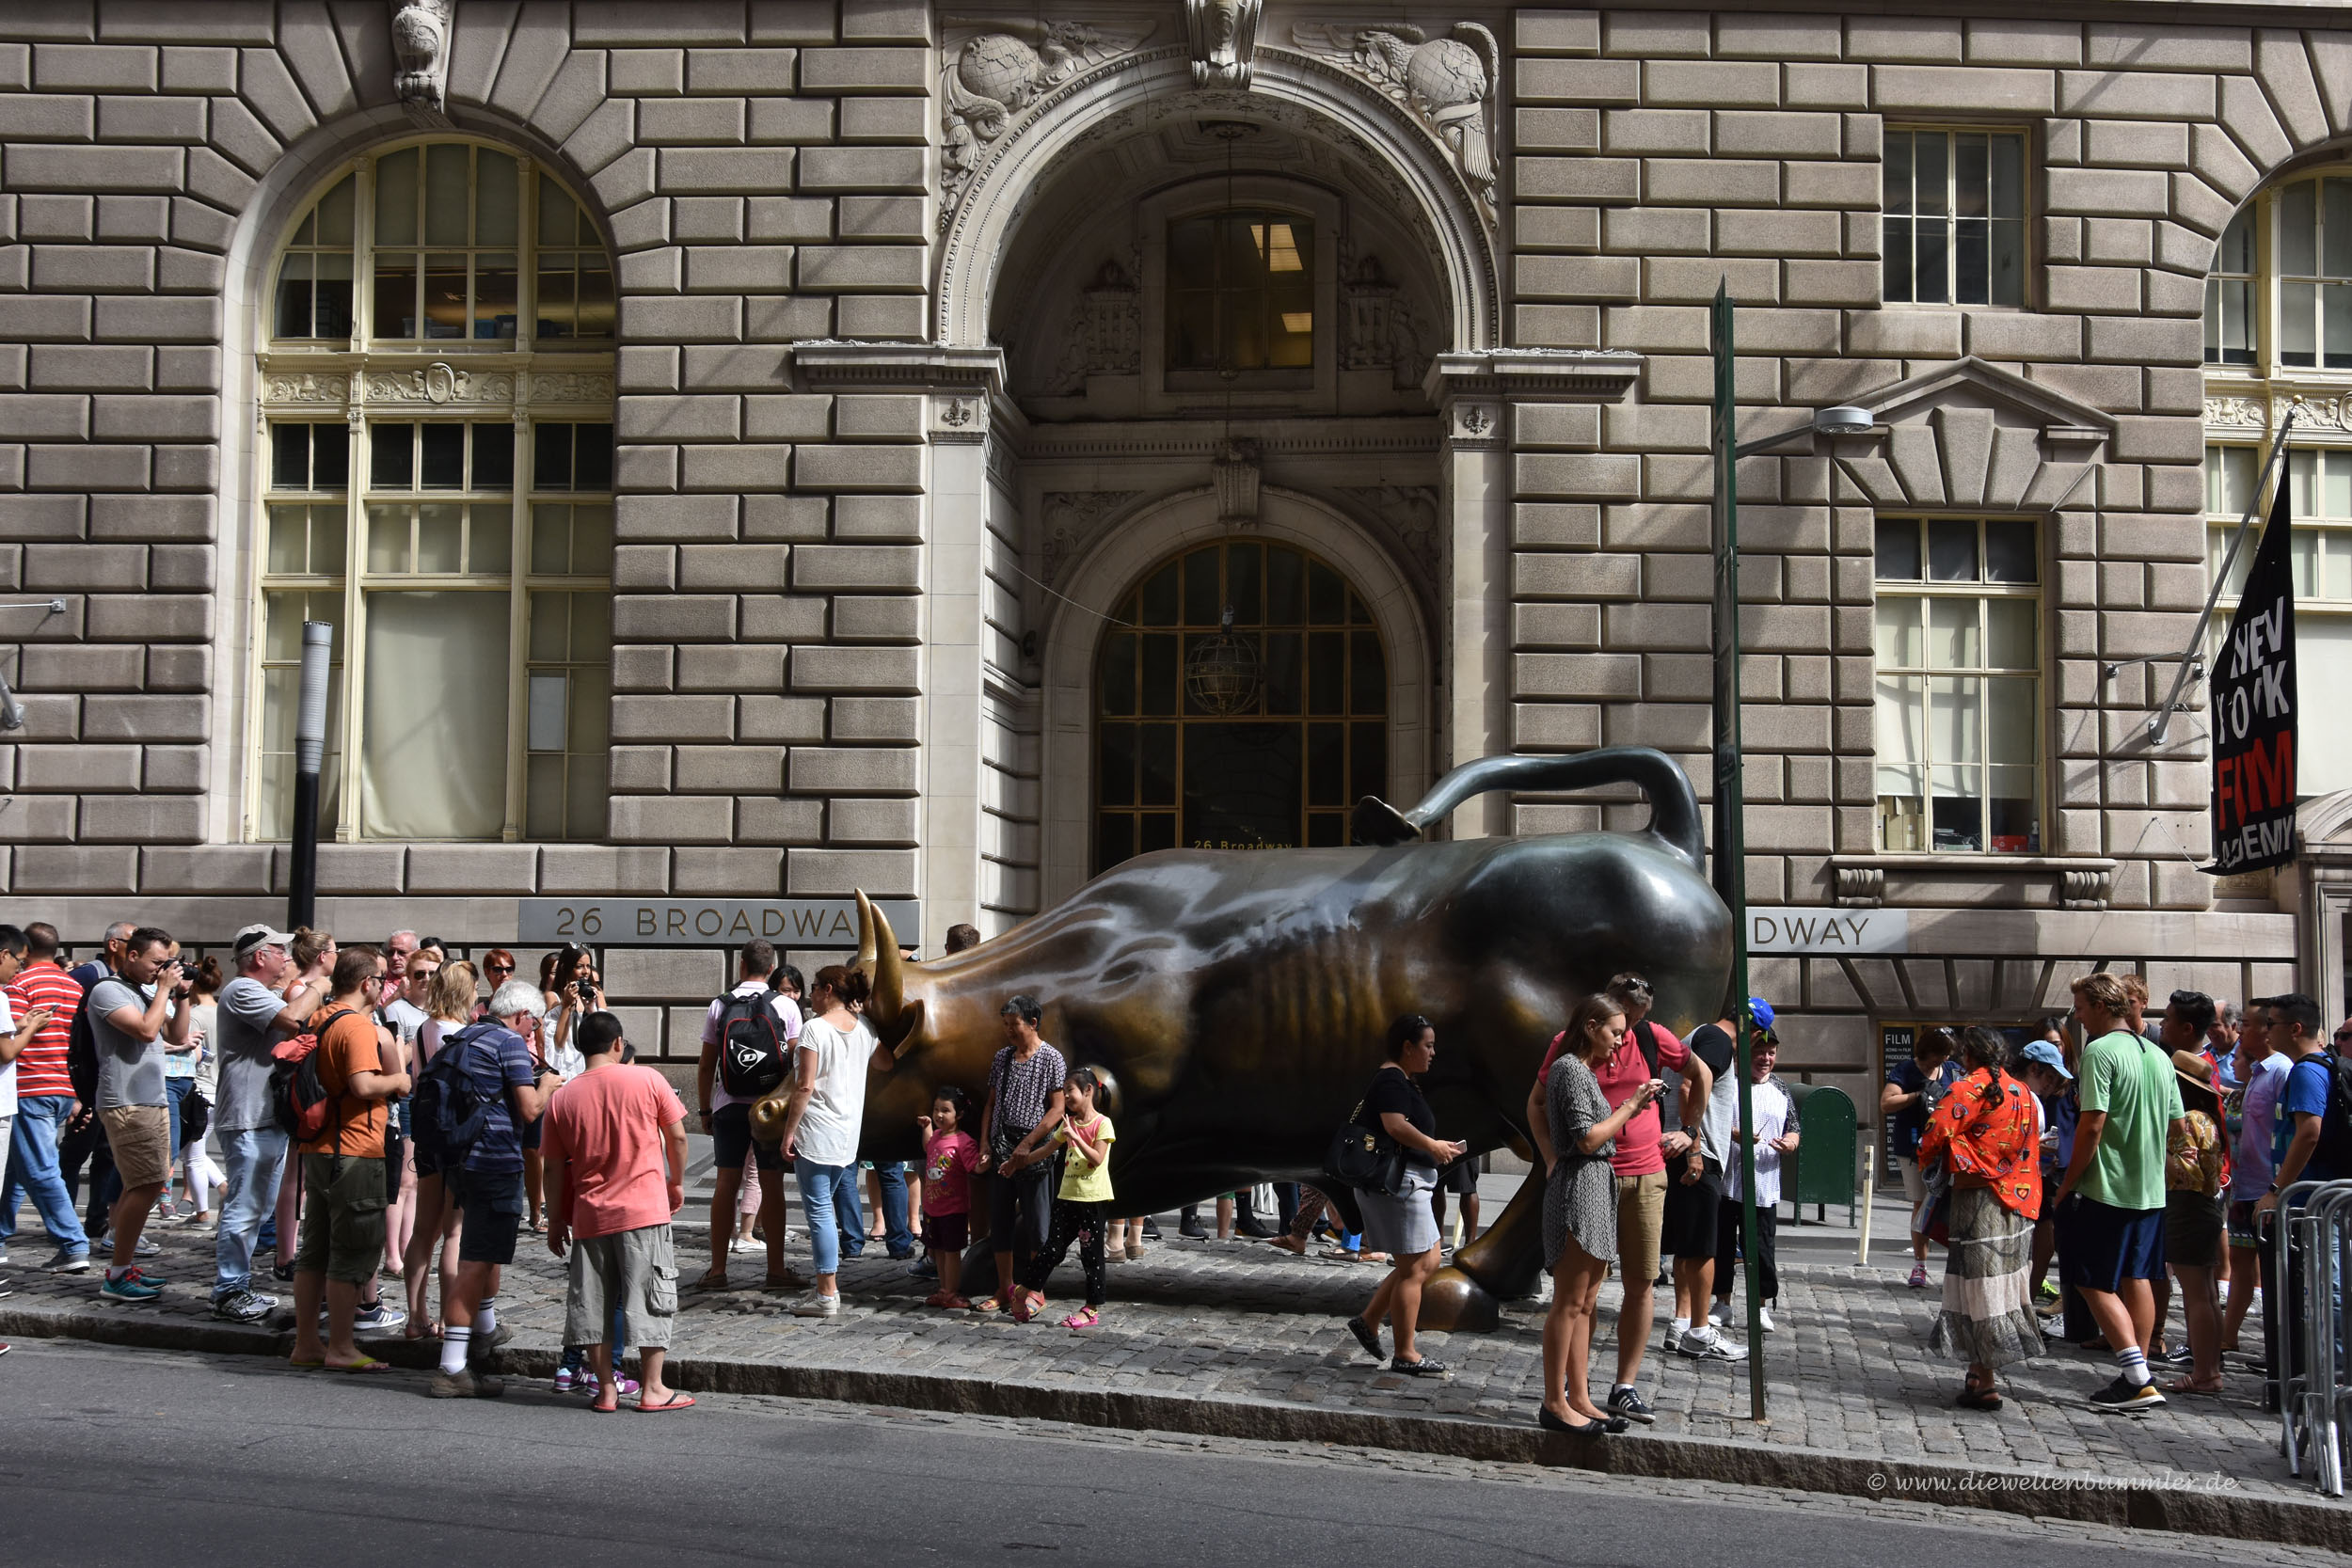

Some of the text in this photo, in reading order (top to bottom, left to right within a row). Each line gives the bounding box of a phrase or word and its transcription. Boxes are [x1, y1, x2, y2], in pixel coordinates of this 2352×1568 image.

[1194, 840, 1293, 850] 26 Broadway
[556, 908, 859, 938] 26 BROADWA
[1754, 916, 1869, 946] DWAY
[1885, 1035, 1911, 1045] FILM
